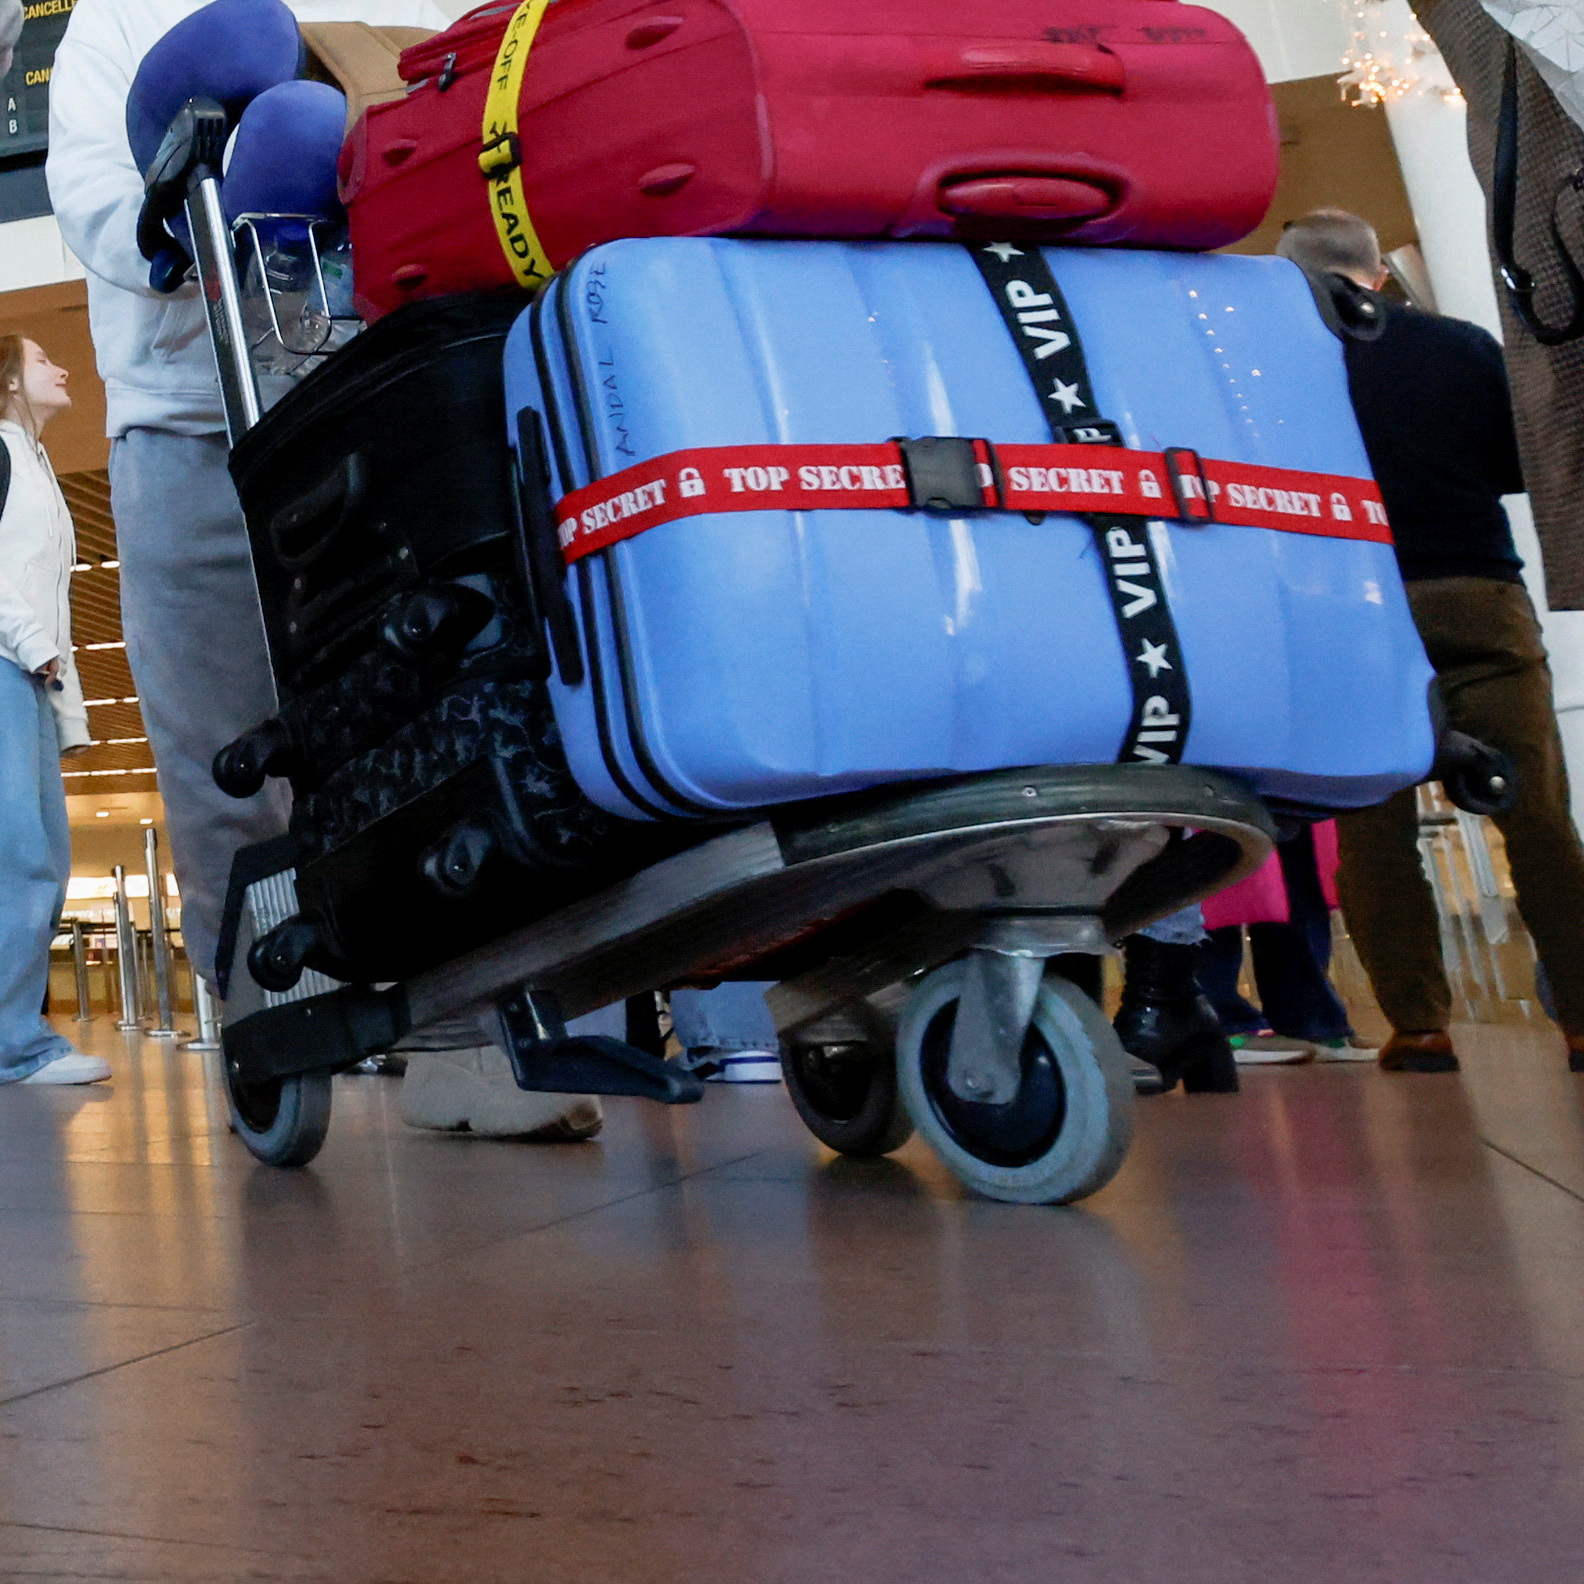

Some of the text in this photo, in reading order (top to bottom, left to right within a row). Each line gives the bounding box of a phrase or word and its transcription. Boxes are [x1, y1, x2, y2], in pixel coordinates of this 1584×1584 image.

[1004, 279, 1073, 361] VIP
[580, 478, 667, 535] SECRET
[722, 466, 790, 493] TOP
[798, 464, 906, 491] SECRE
[1008, 466, 1124, 495] SECRET
[1226, 482, 1322, 517] SECRET
[1105, 526, 1154, 620] VIP
